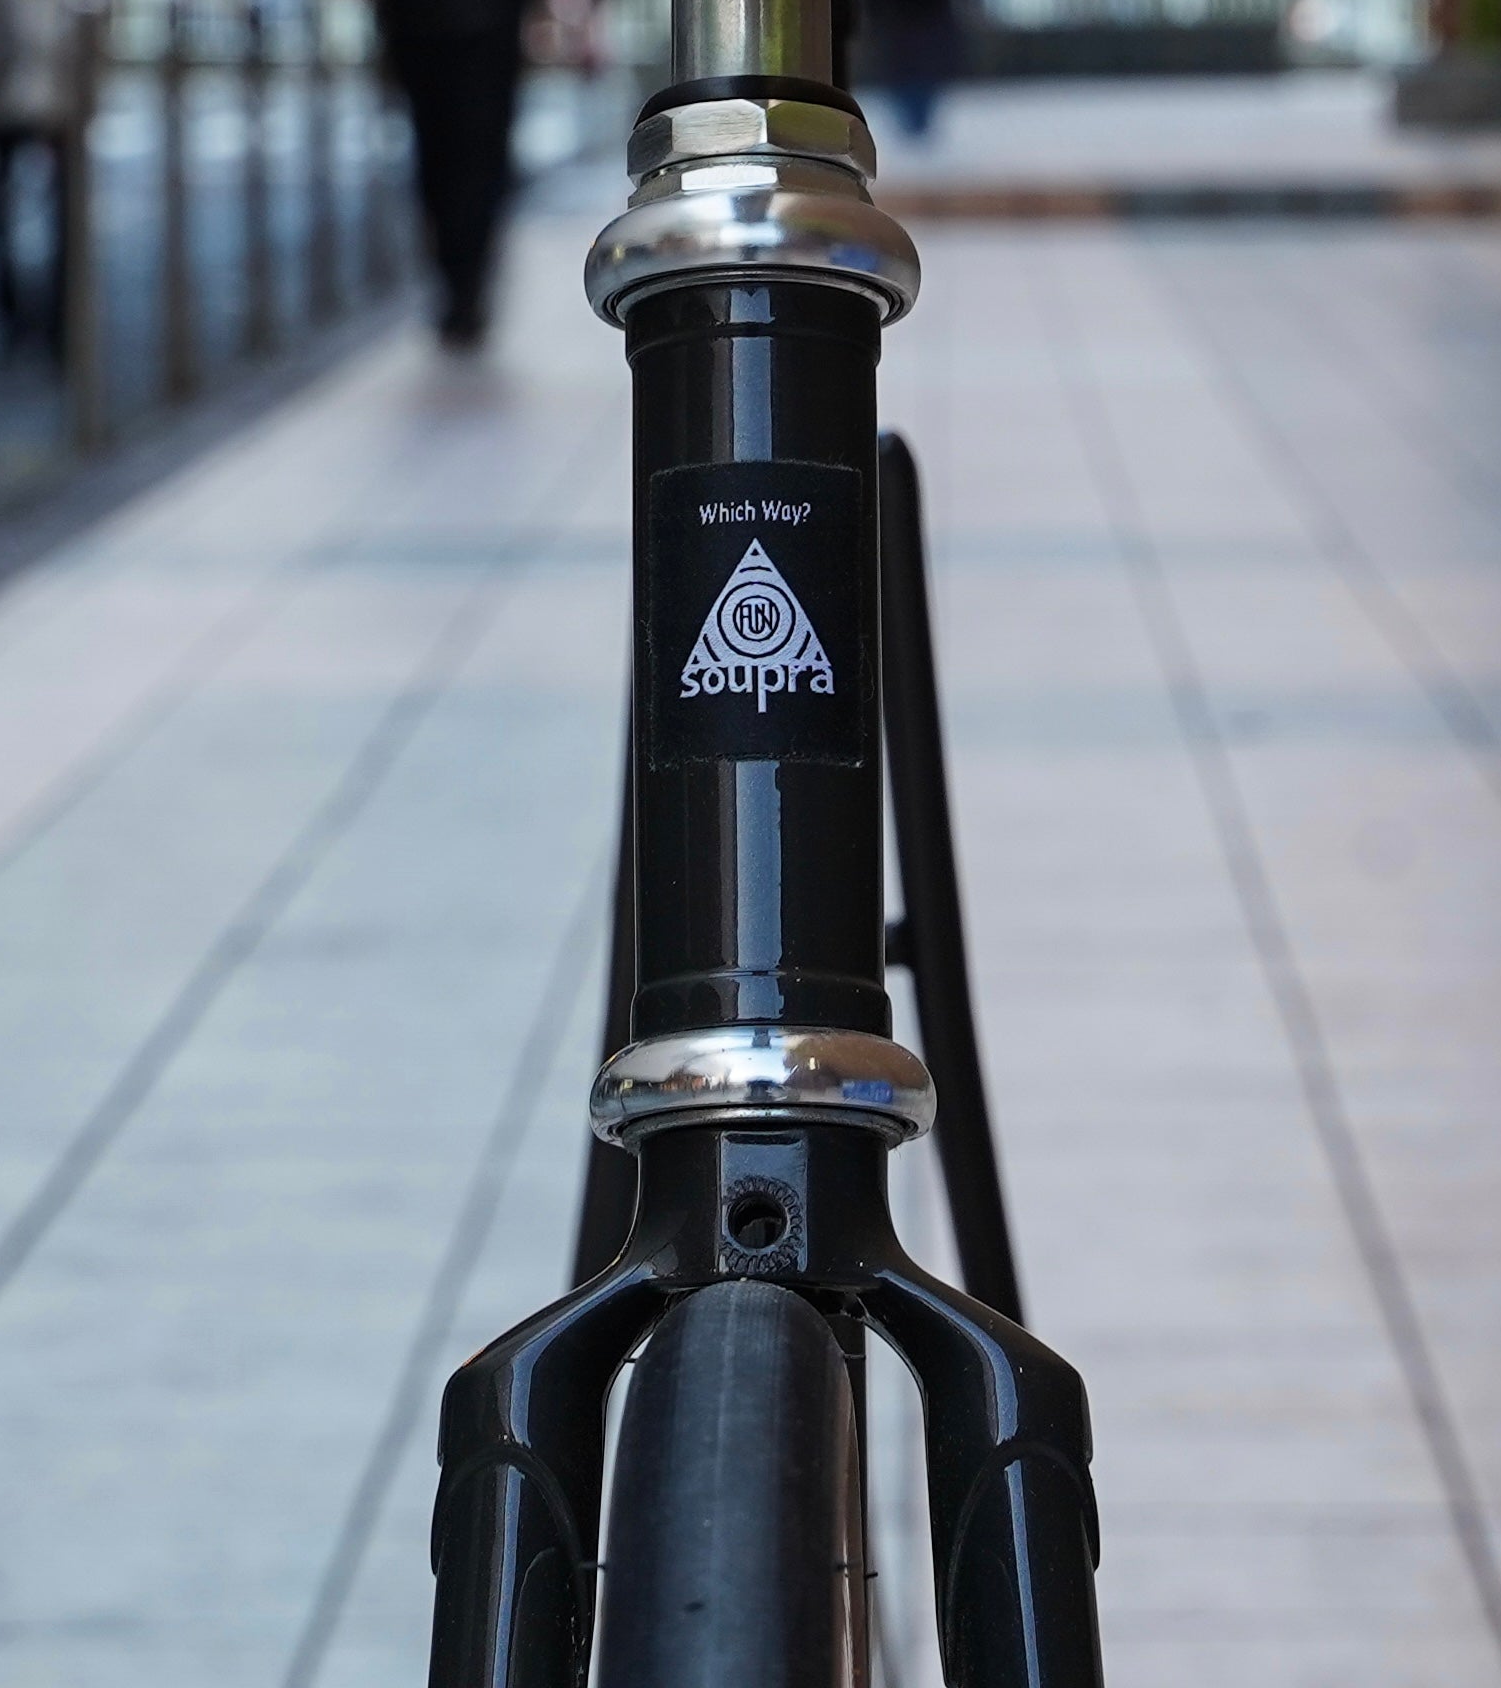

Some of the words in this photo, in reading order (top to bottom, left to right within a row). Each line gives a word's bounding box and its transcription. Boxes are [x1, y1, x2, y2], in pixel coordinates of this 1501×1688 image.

[699, 499, 756, 526] Which
[761, 499, 812, 527] Way?
[679, 663, 836, 713] soupra
